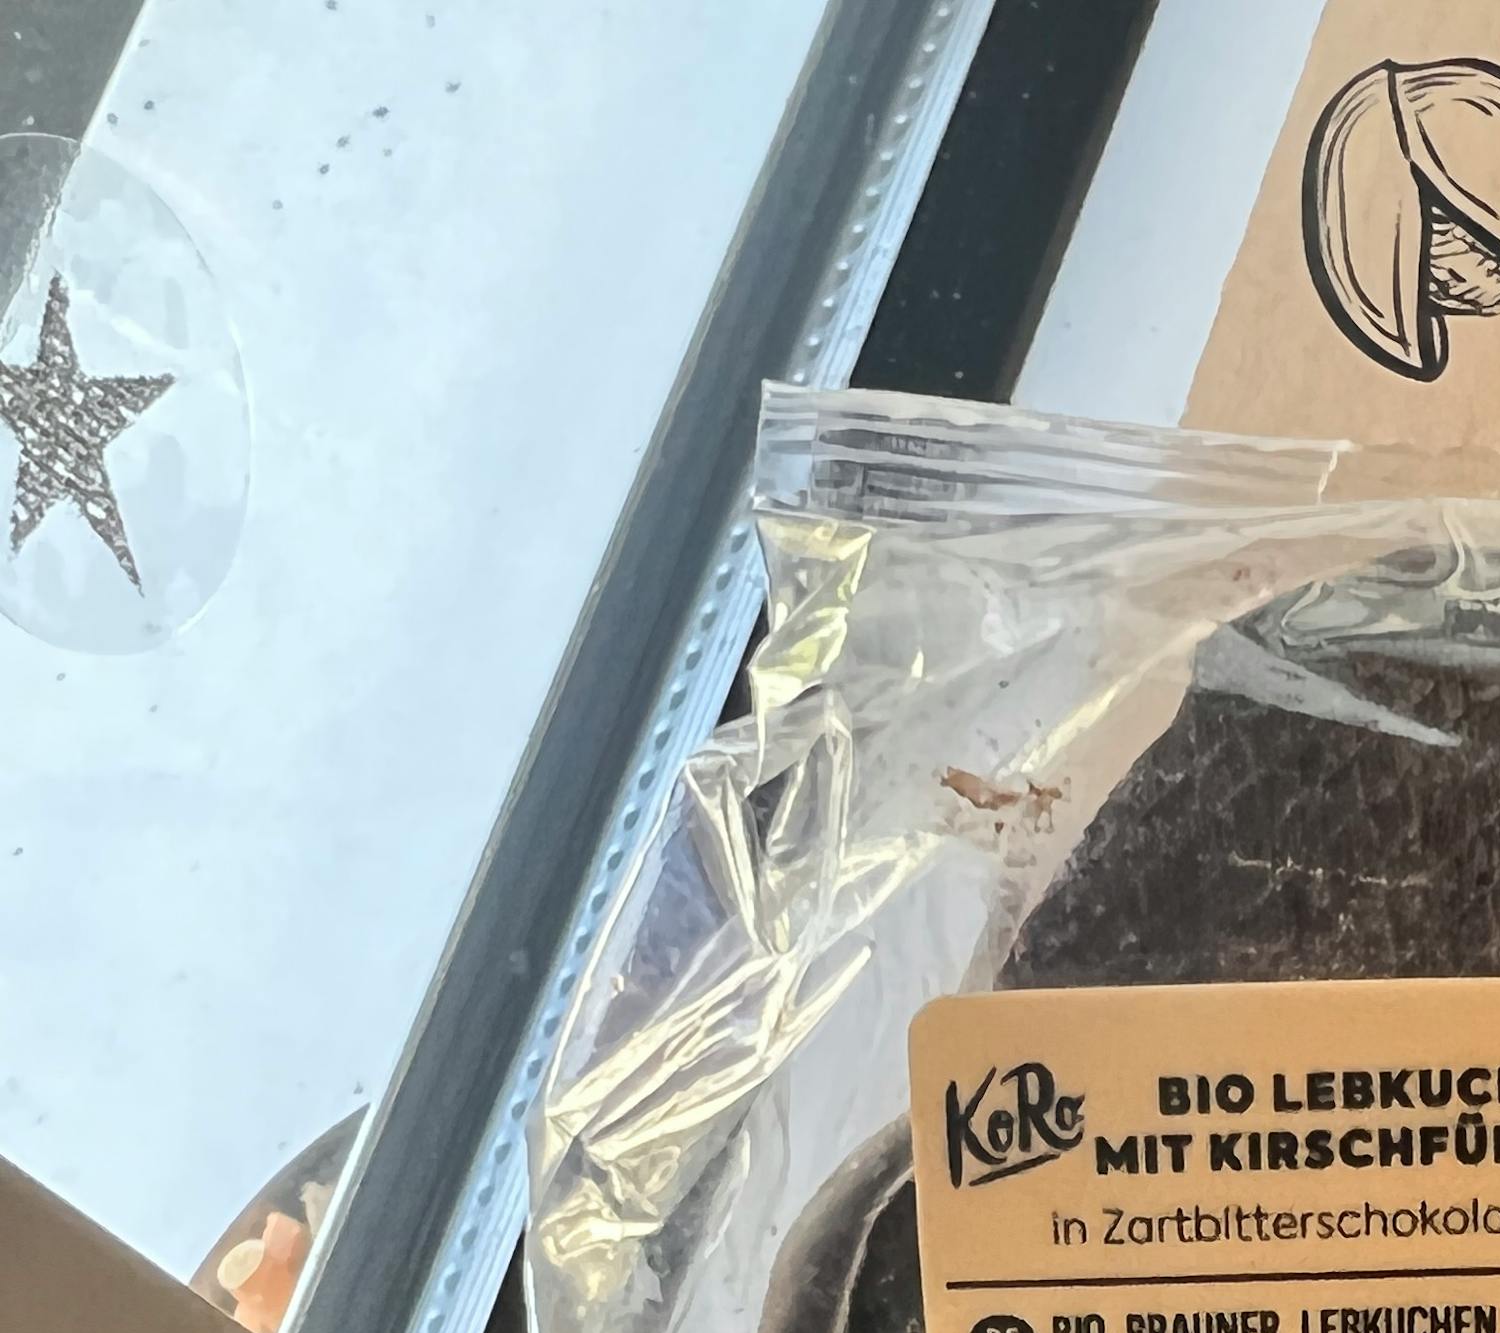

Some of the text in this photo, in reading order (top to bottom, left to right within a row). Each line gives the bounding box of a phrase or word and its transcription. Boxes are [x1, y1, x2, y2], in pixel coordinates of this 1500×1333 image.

[1158, 1073, 1255, 1116] BIO
[1094, 1133, 1193, 1176] MIT
[1051, 1211, 1088, 1246] in
